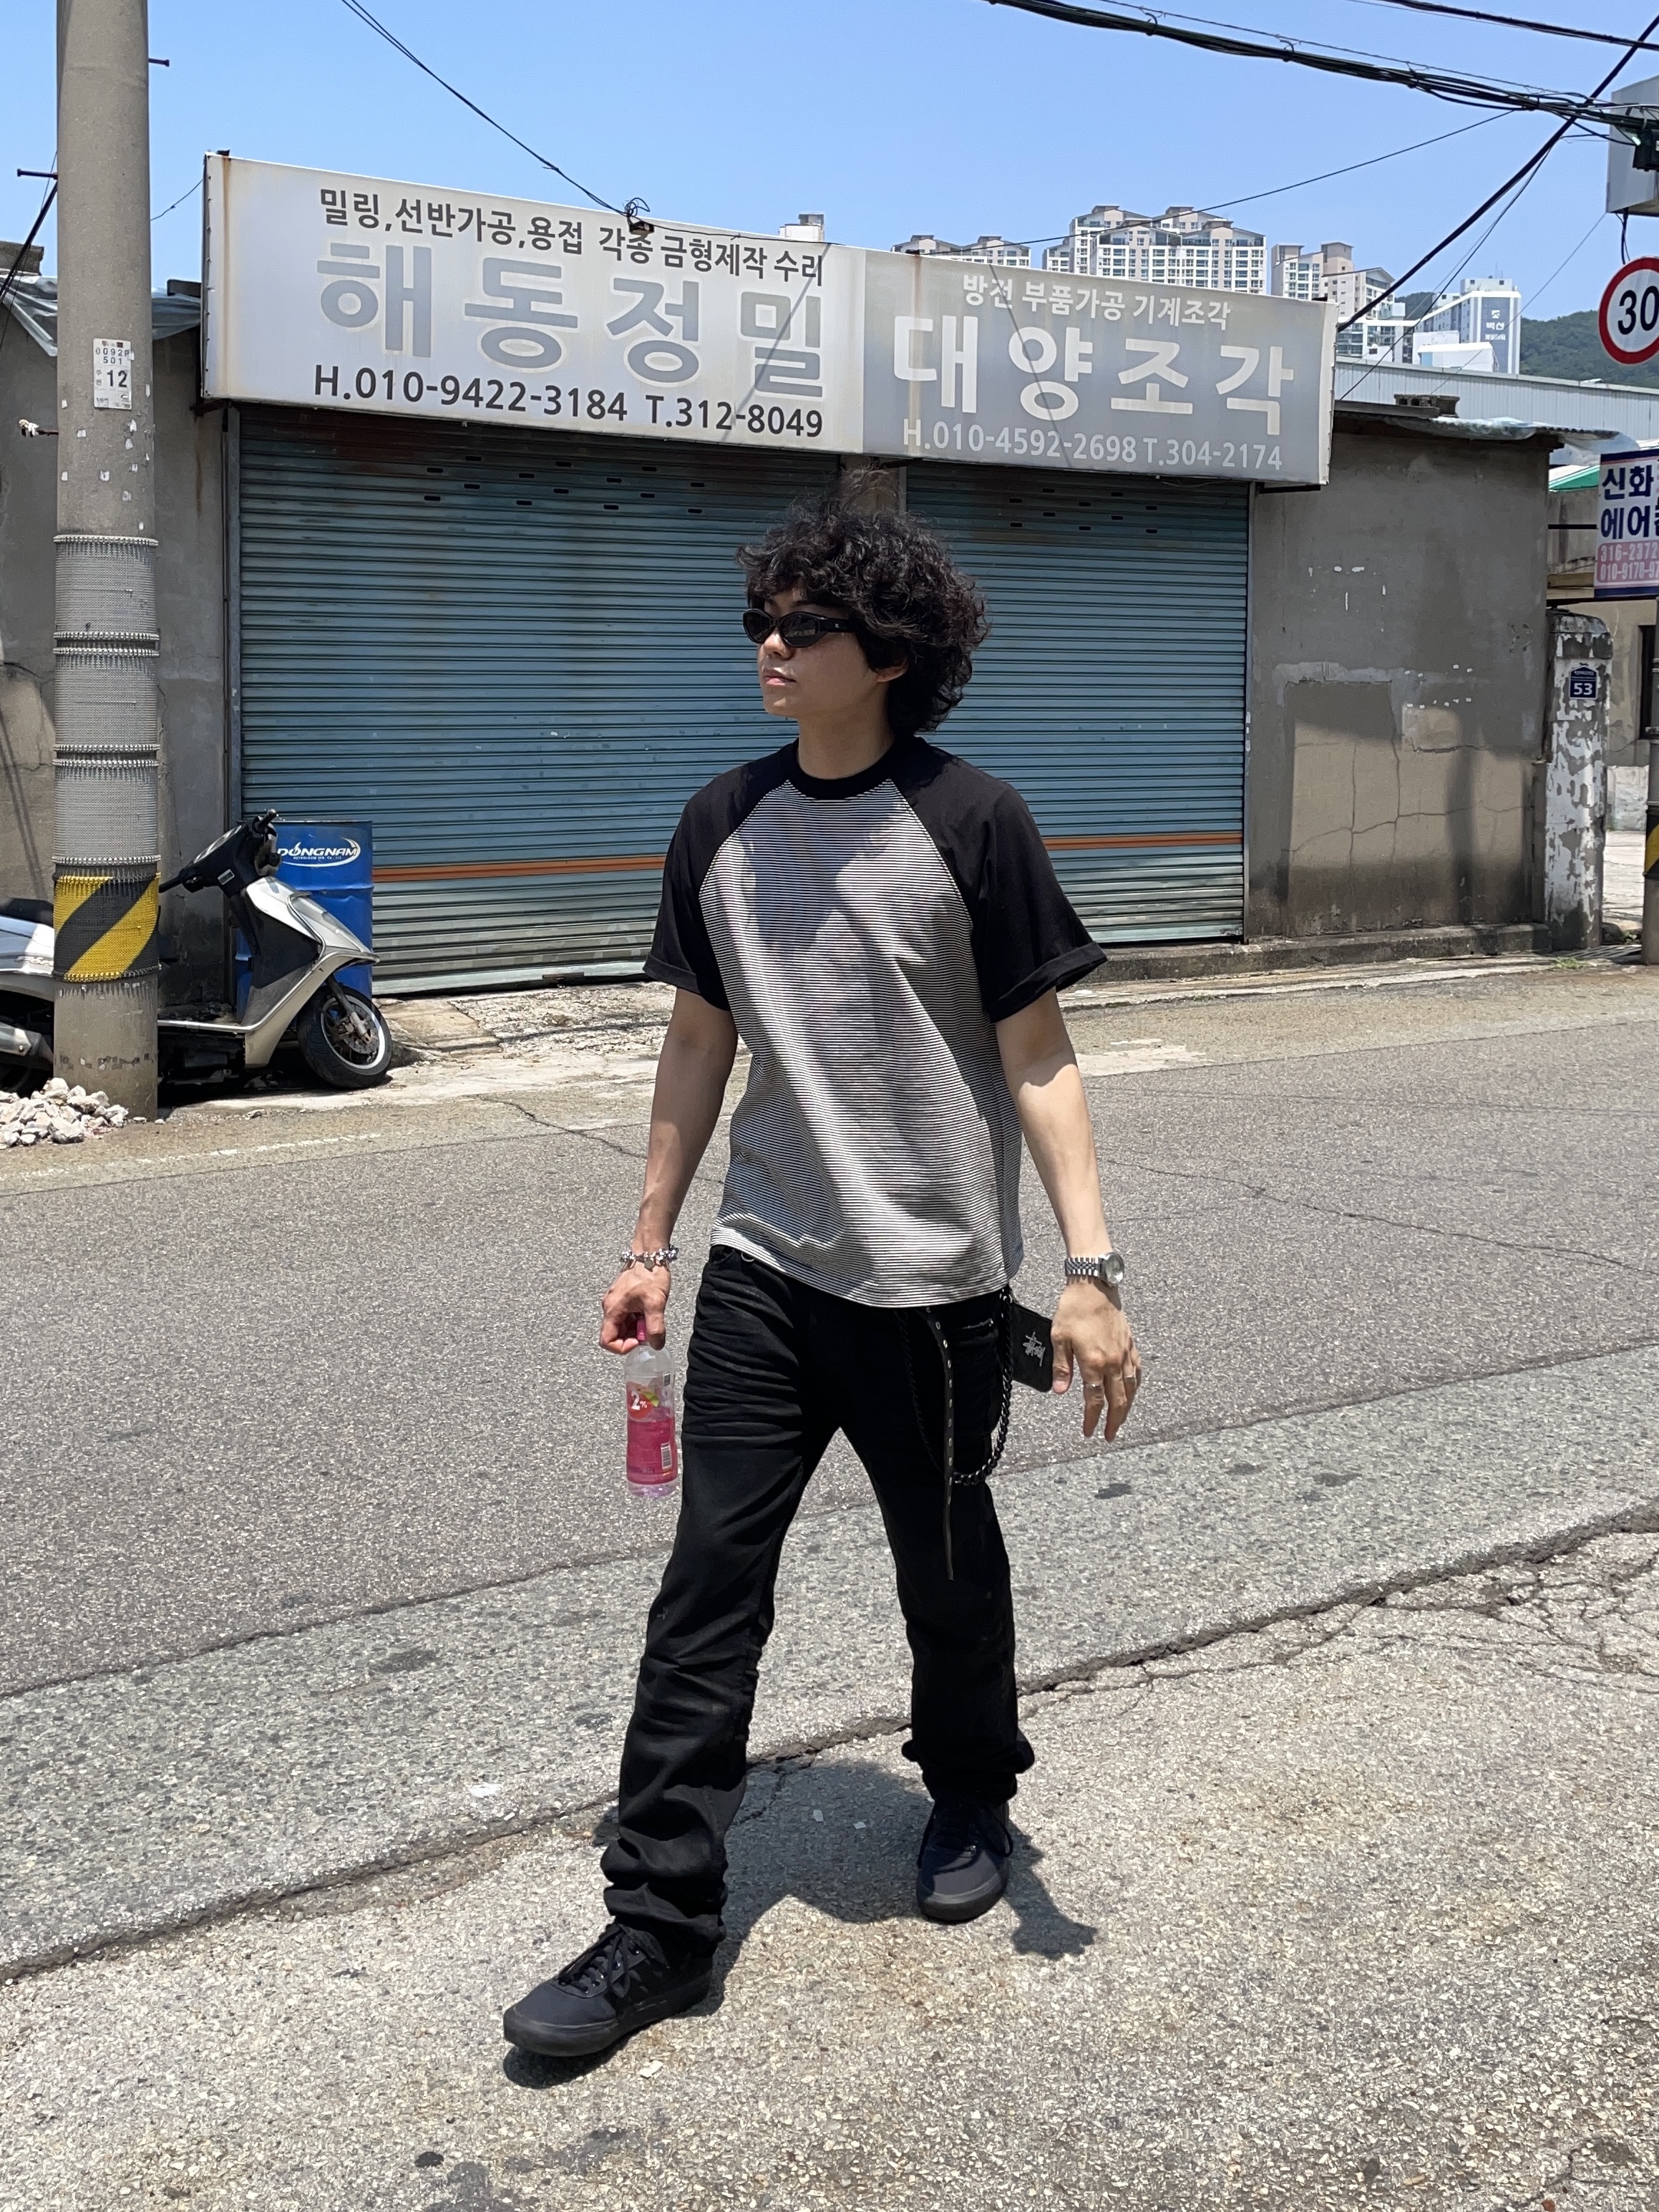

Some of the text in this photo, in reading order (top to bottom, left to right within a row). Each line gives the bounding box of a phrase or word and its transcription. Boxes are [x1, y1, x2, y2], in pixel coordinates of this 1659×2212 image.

[599, 227, 653, 264] 각종
[661, 236, 767, 280] 금형제작
[774, 251, 822, 286] 수리
[317, 242, 823, 398] 해동정밀
[963, 274, 1231, 331] 방전 부품가공 기계조각
[1617, 286, 1659, 335] 30
[107, 369, 127, 388] 12
[314, 364, 823, 437] H.010-9422-3184 T.312-8049
[894, 315, 1294, 435] 대양조각
[903, 418, 1282, 470] H.010-4592-2698 T.304-2174
[1602, 465, 1654, 500] 신화
[1574, 682, 1593, 695] 53
[277, 844, 357, 856] DONGNAM
